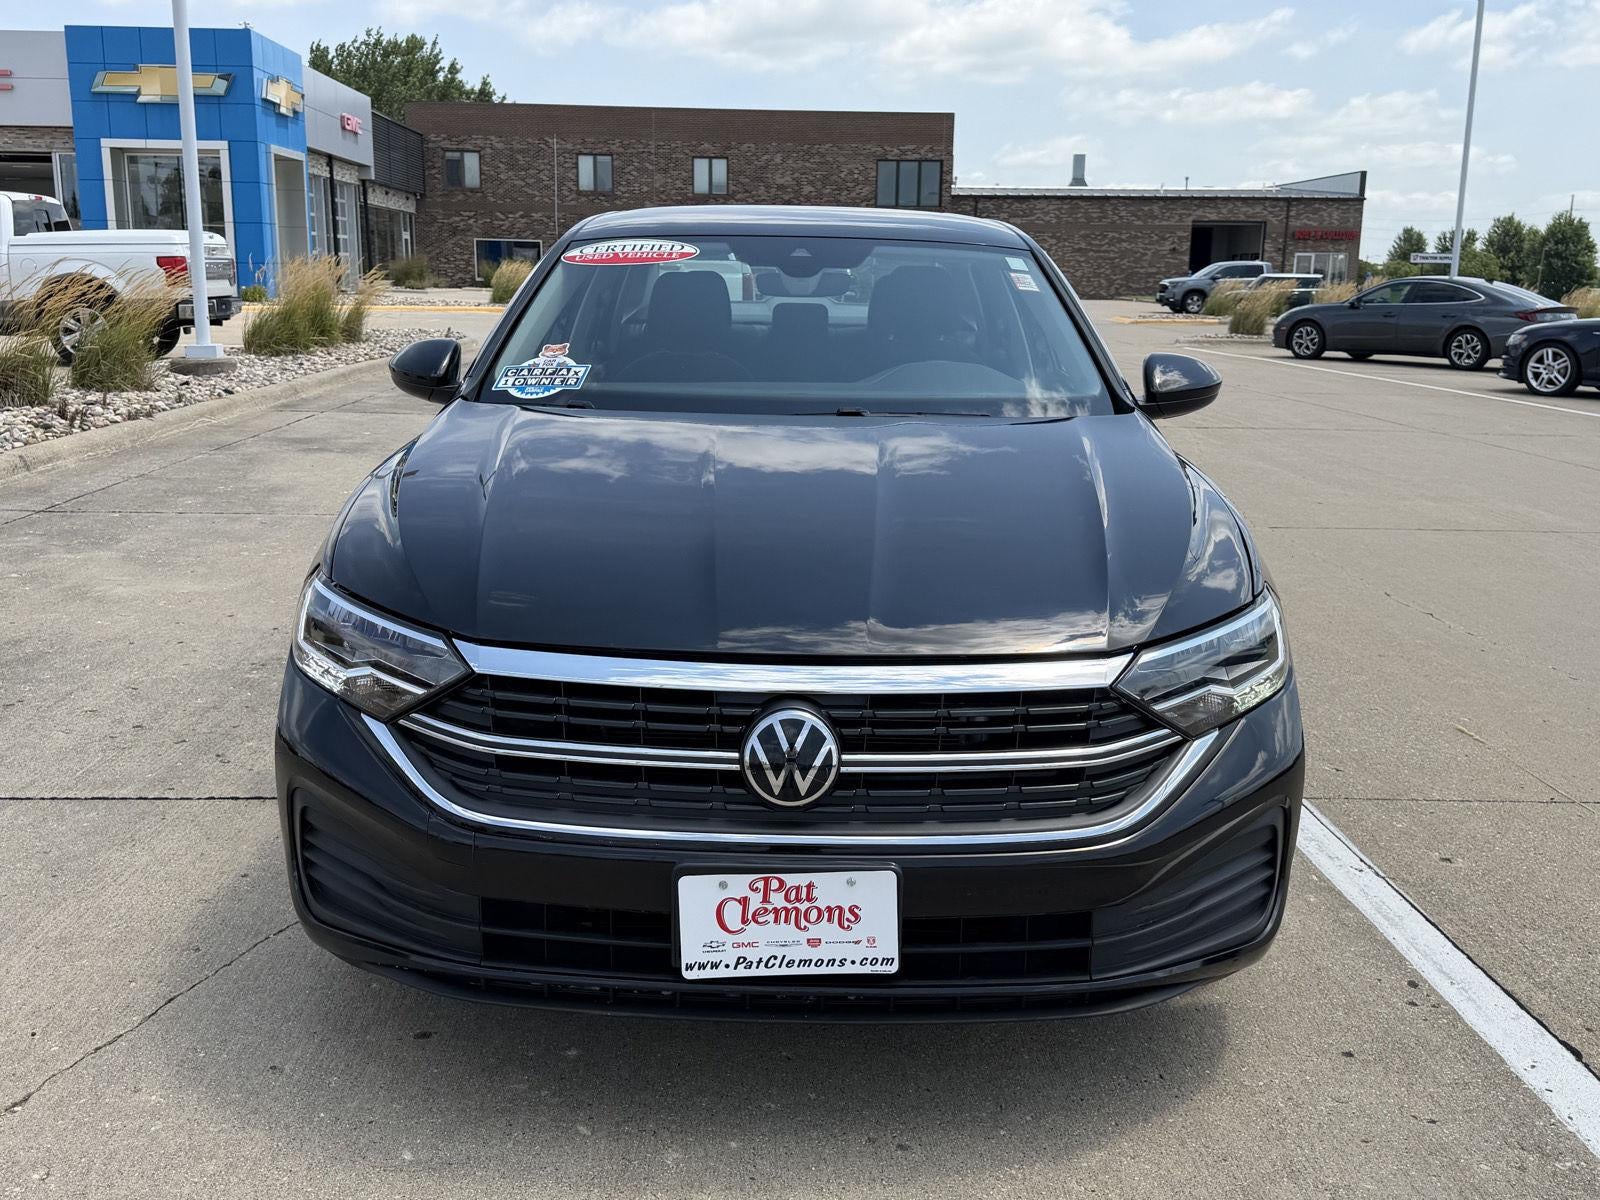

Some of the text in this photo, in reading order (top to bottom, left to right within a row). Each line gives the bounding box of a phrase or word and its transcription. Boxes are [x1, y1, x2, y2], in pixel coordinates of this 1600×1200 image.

[580, 243, 685, 254] CERTIFIED
[575, 251, 680, 261] USED VEHICLE
[506, 368, 581, 377] CARFAX
[513, 377, 578, 386] OWNER
[748, 875, 819, 906] Pat
[715, 895, 862, 935] Clemons
[731, 941, 760, 949] GMC
